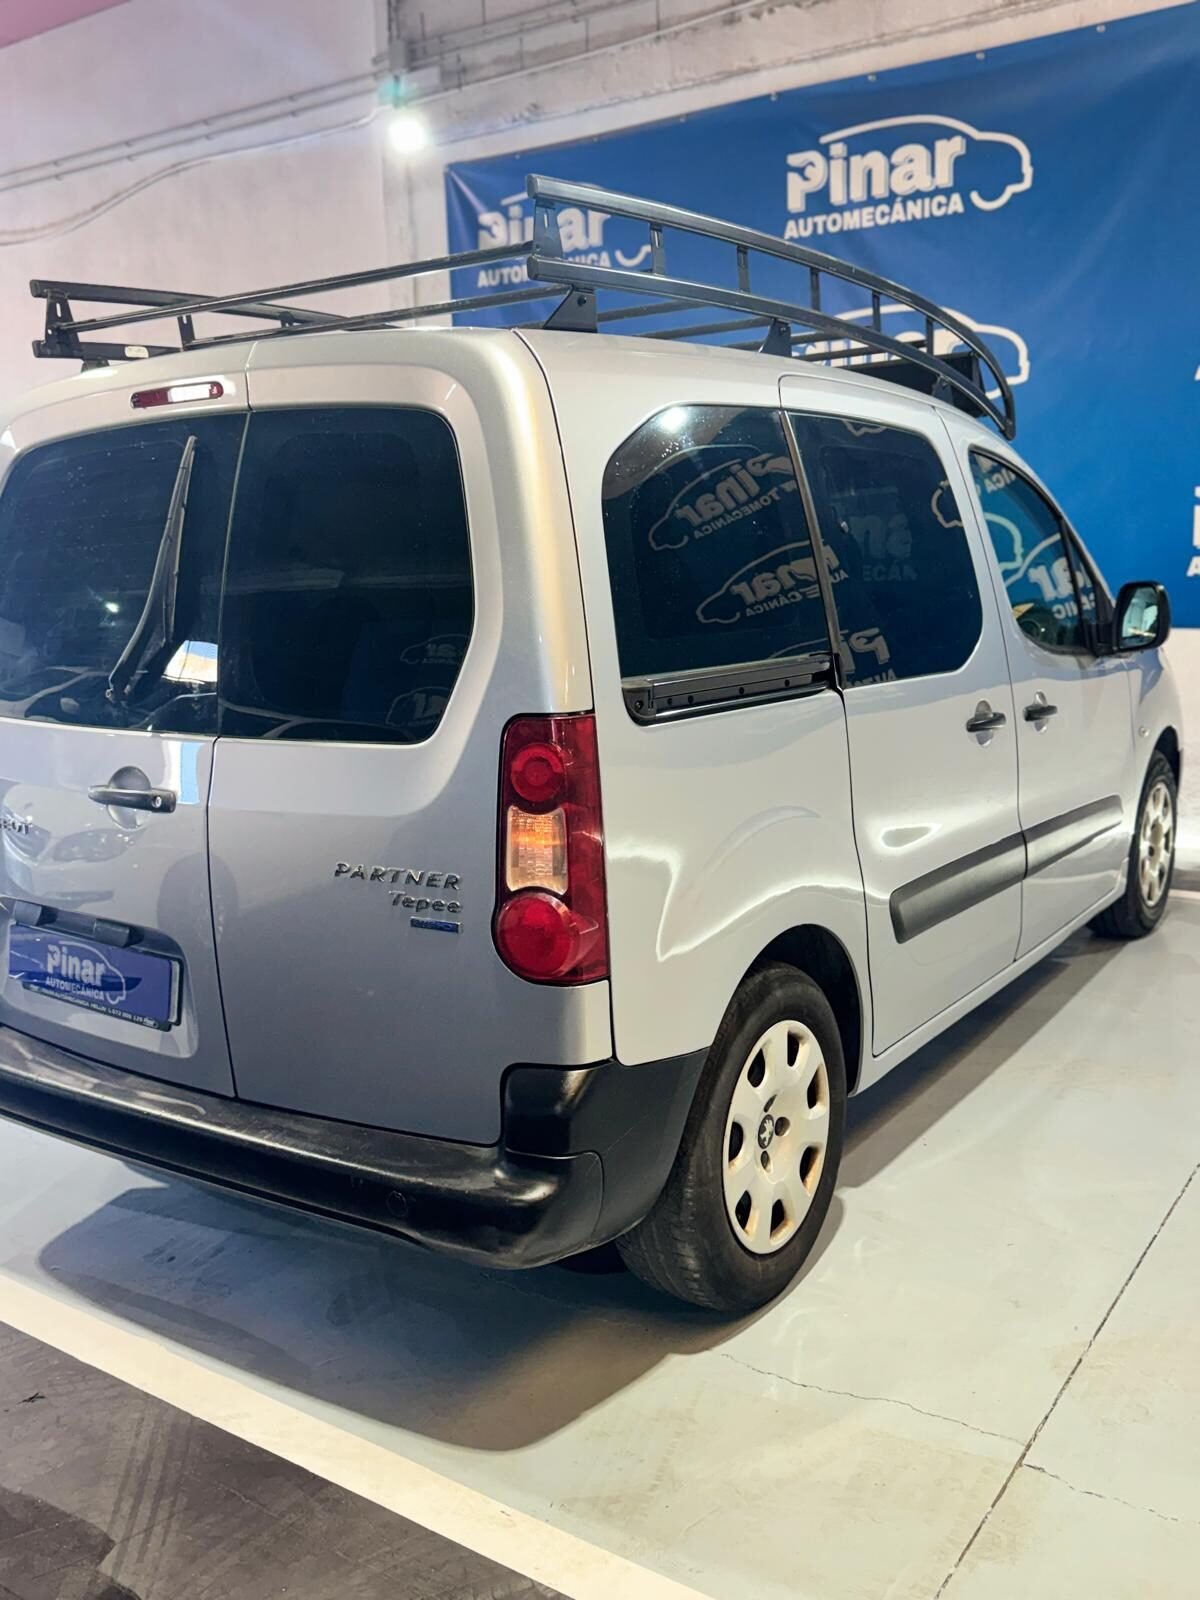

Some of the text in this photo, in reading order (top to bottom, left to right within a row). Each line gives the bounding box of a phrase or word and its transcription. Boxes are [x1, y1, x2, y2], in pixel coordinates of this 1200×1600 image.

[786, 134, 967, 213] Pinar
[783, 192, 965, 240] AUTOMECÁNICA
[334, 861, 462, 891] PARTNER
[388, 890, 462, 913] Tepee
[47, 944, 106, 987] Pinar
